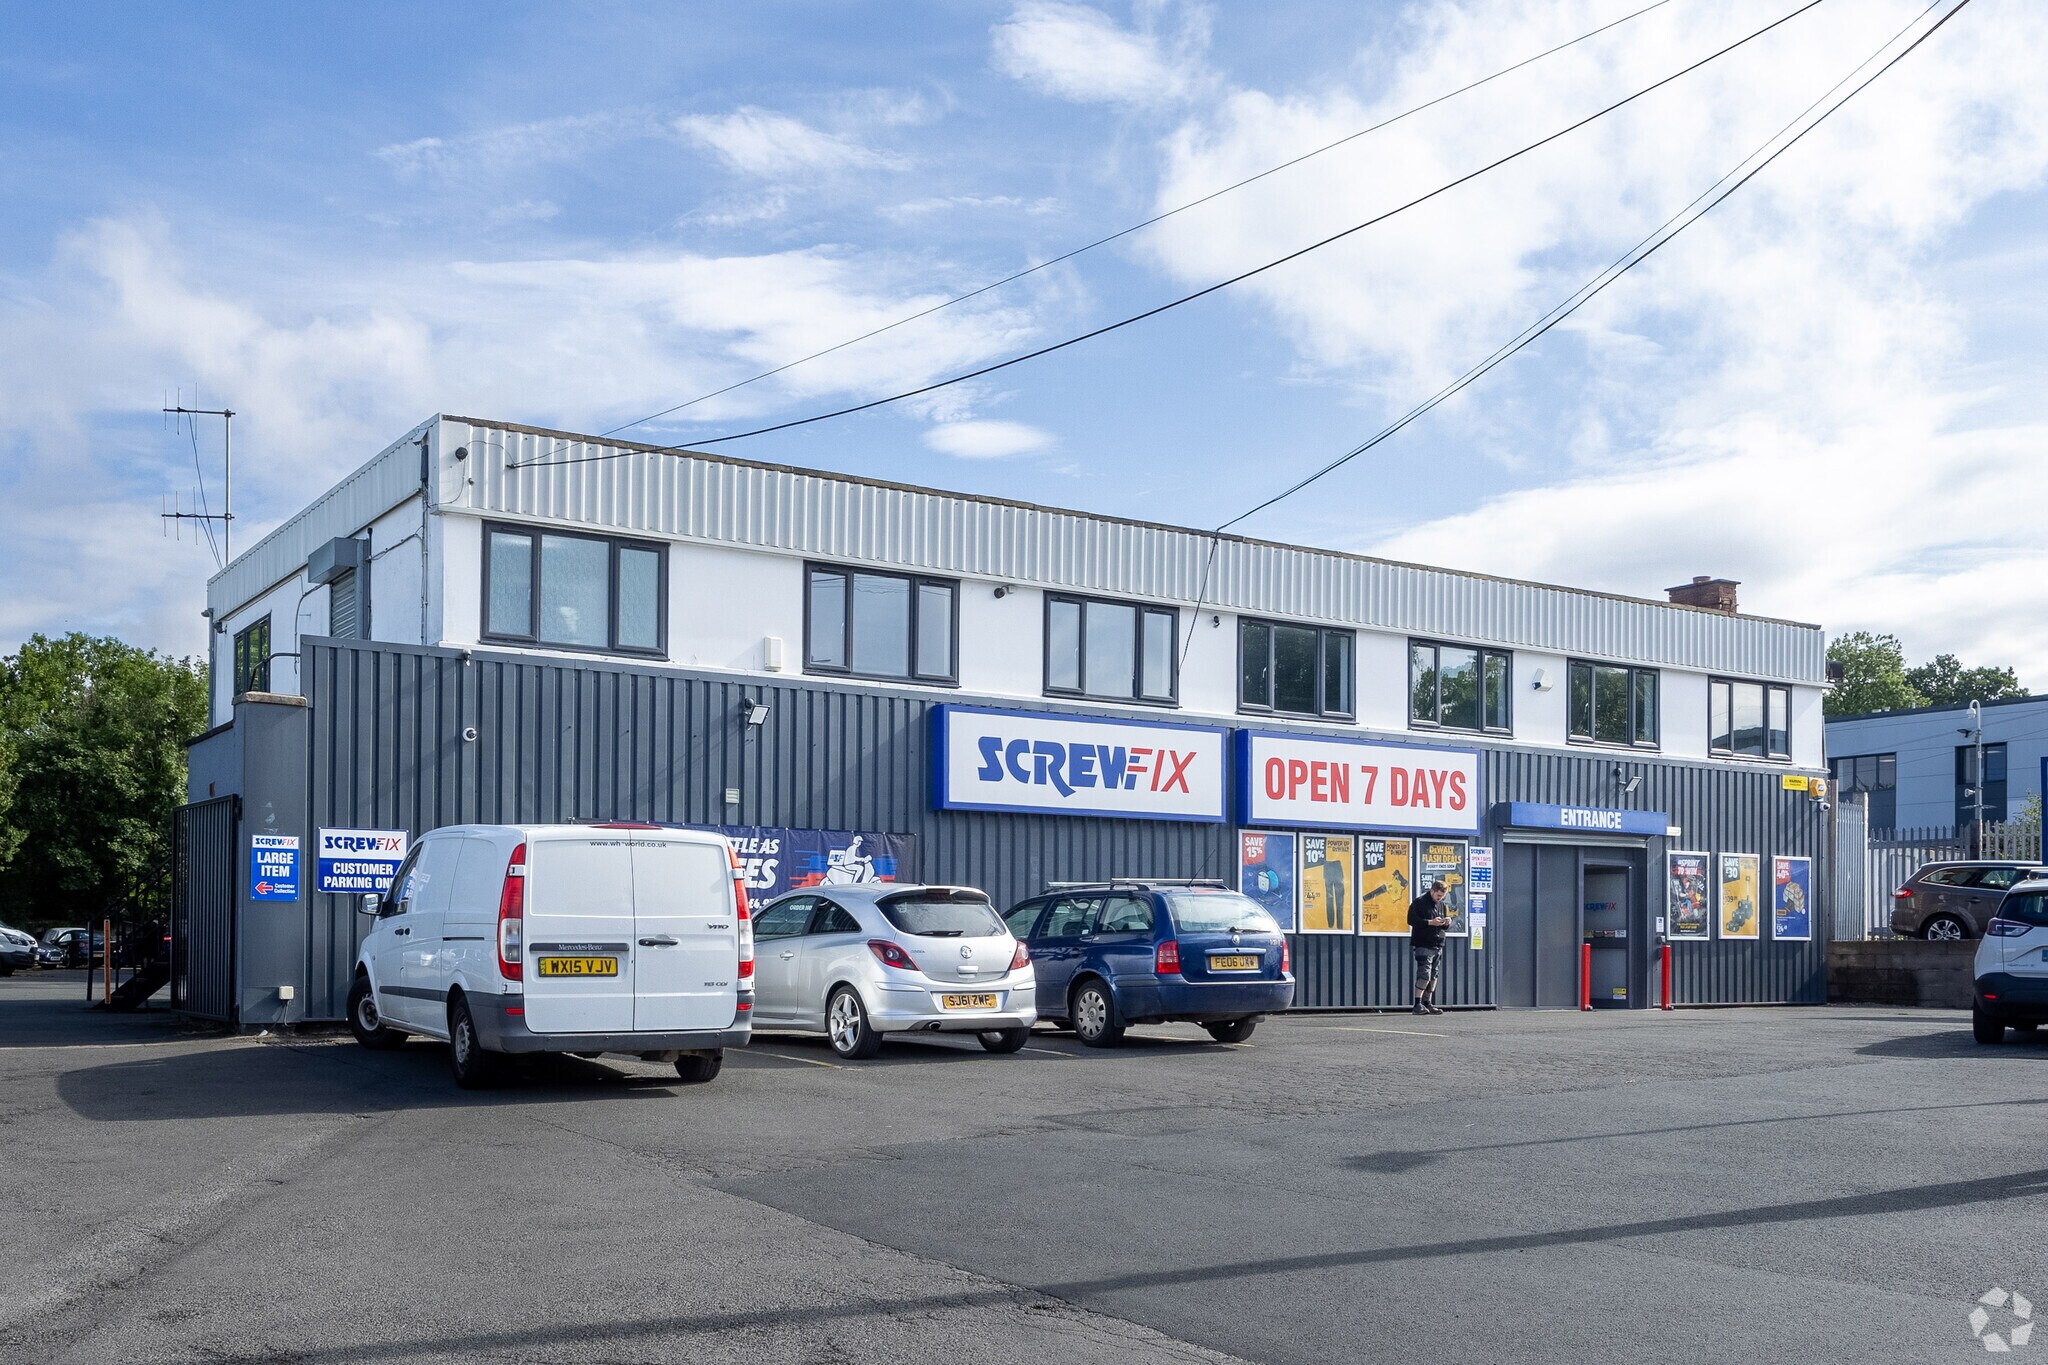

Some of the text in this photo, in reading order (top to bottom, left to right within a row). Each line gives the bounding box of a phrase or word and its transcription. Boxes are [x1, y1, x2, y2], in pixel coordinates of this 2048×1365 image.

[977, 736, 1197, 798] SCREWFIX
[1265, 757, 1467, 811] OPEN 7 DAYS
[1561, 808, 1622, 829] ENTRANCE
[255, 838, 296, 847] SCREWFIX
[325, 836, 402, 852] SCREWFIX
[759, 838, 780, 854] AS
[1245, 836, 1263, 846] SAVE
[1306, 838, 1325, 849] SAVE
[1246, 847, 1262, 858] 15%
[1365, 842, 1384, 853] SAVE
[257, 852, 294, 864] LARGE
[1306, 850, 1324, 863] 10%
[1365, 852, 1384, 866] 10%
[1422, 854, 1462, 864] FLASH DEALS
[1724, 858, 1739, 867] SAVE
[1777, 862, 1789, 870] SAVE
[261, 865, 290, 877] ITEM
[333, 862, 393, 875] CUSTOMER
[324, 877, 372, 888] PARKING
[551, 960, 582, 973] WX15
[586, 960, 612, 973] VJV
[1215, 957, 1238, 968] FE06
[949, 995, 971, 1006] SJ61
